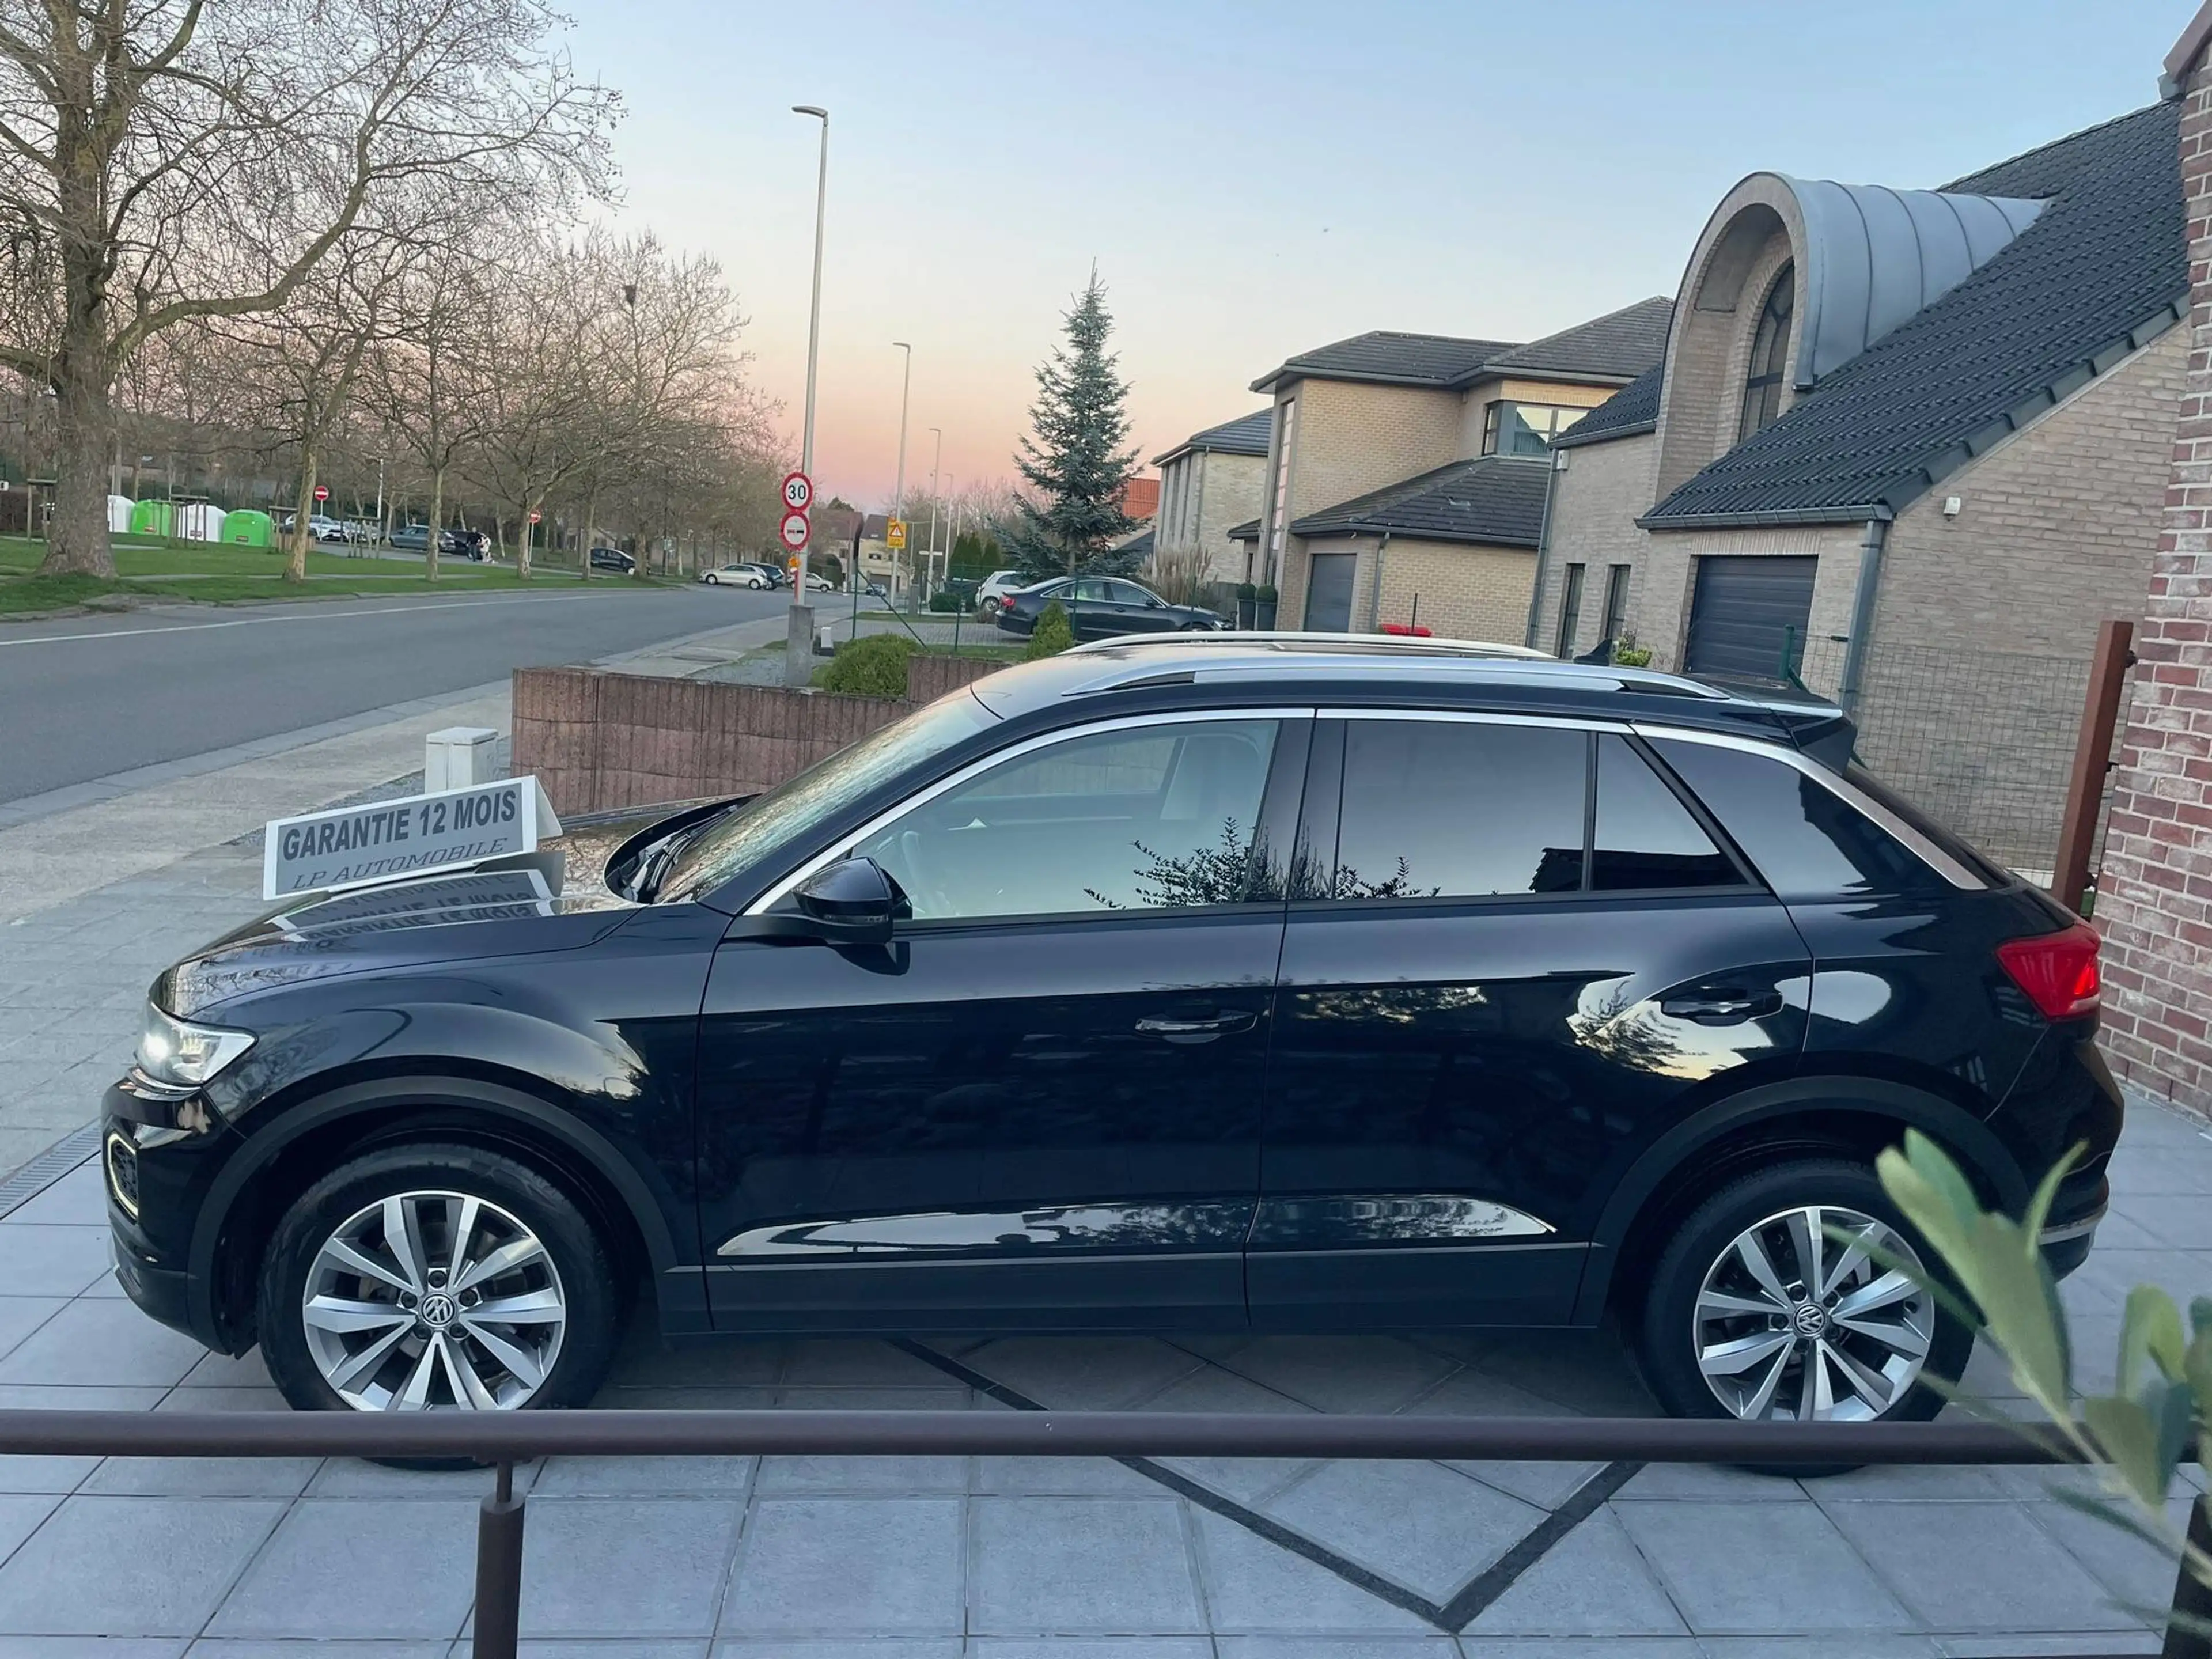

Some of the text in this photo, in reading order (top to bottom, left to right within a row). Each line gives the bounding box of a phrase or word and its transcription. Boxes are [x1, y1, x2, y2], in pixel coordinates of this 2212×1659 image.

[788, 484, 806, 499] 30
[283, 790, 517, 861] GARANTIE 12 MOIS
[292, 838, 508, 889] LP AUTOMOBILE
